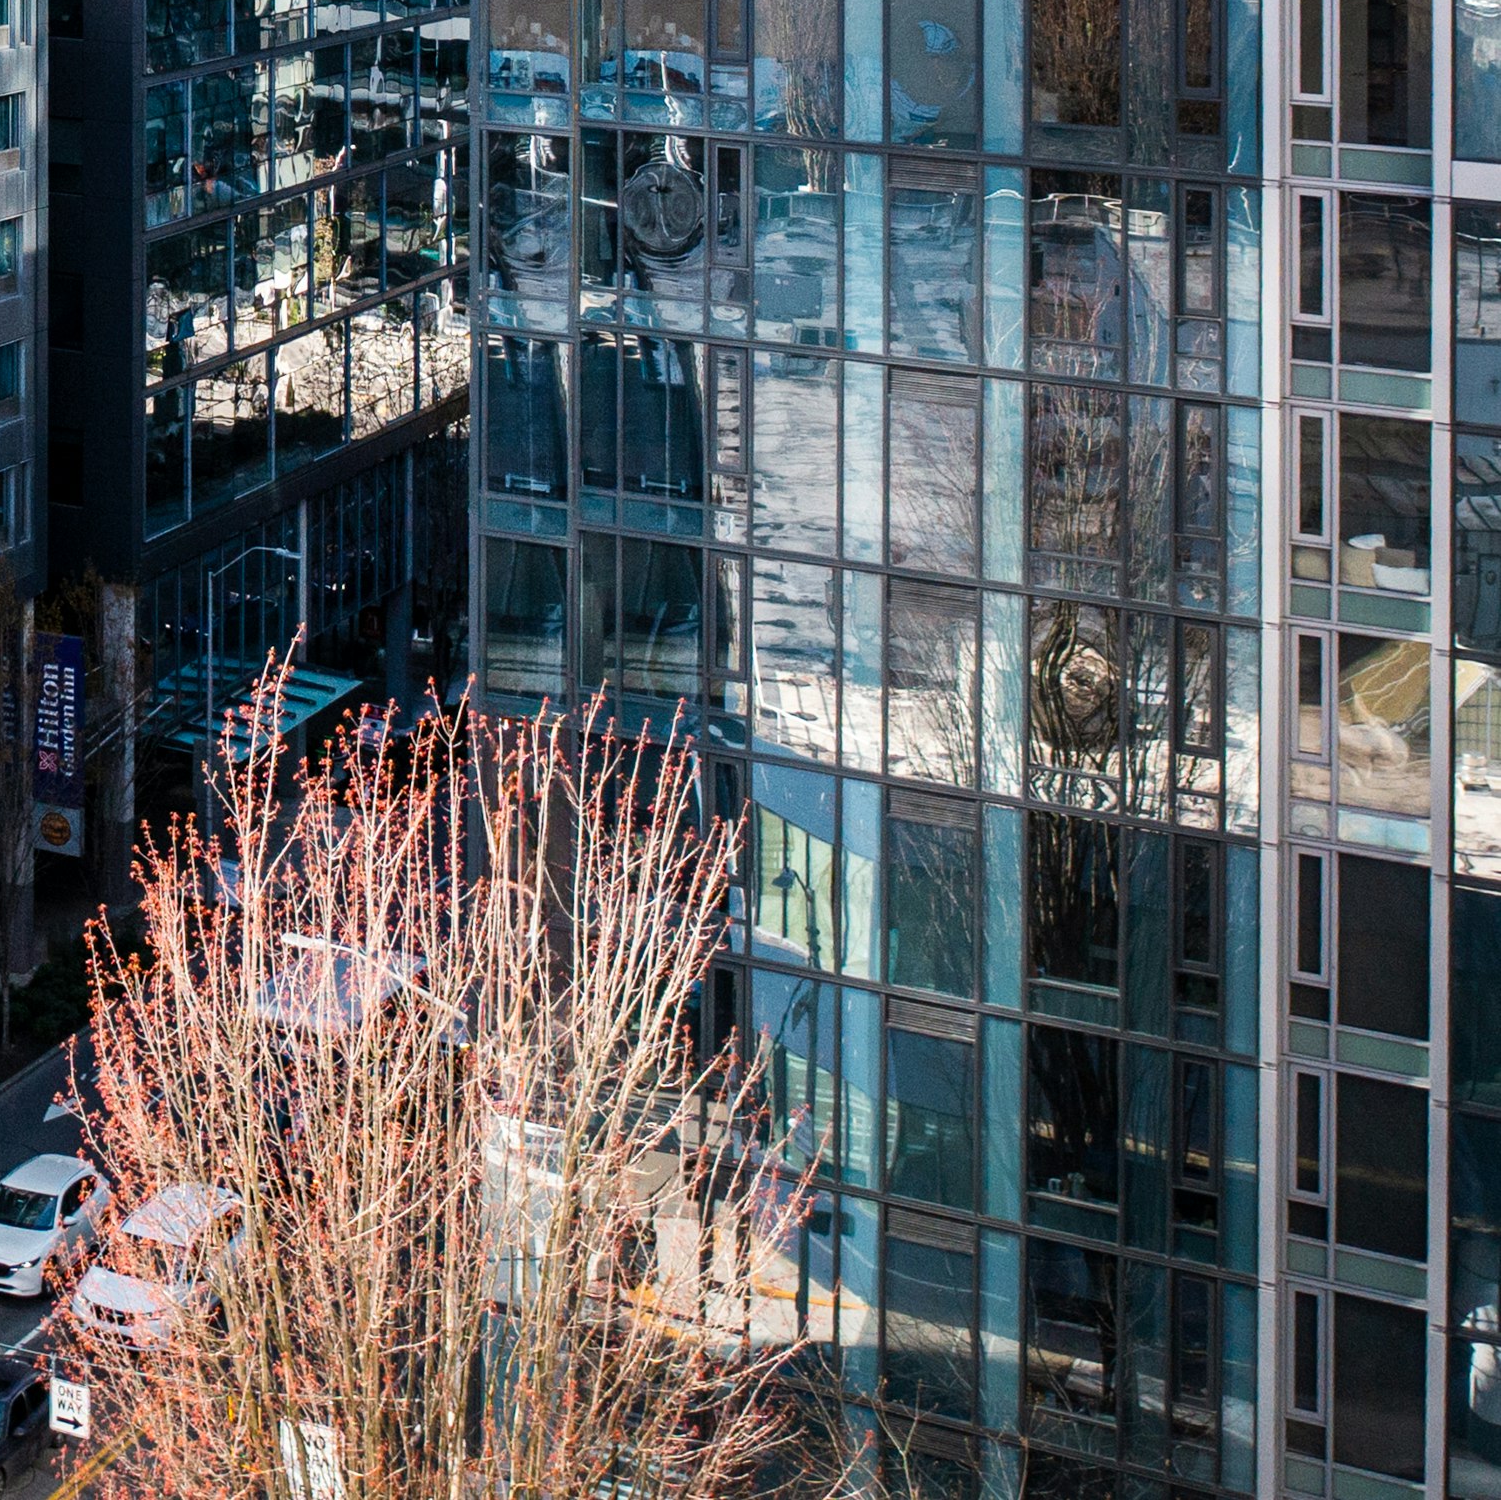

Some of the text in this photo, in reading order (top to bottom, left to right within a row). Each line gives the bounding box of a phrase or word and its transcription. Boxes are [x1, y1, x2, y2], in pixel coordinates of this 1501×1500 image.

[38, 663, 59, 750] Hilton
[57, 1385, 83, 1402] ONE
[57, 1397, 84, 1414] WAY
